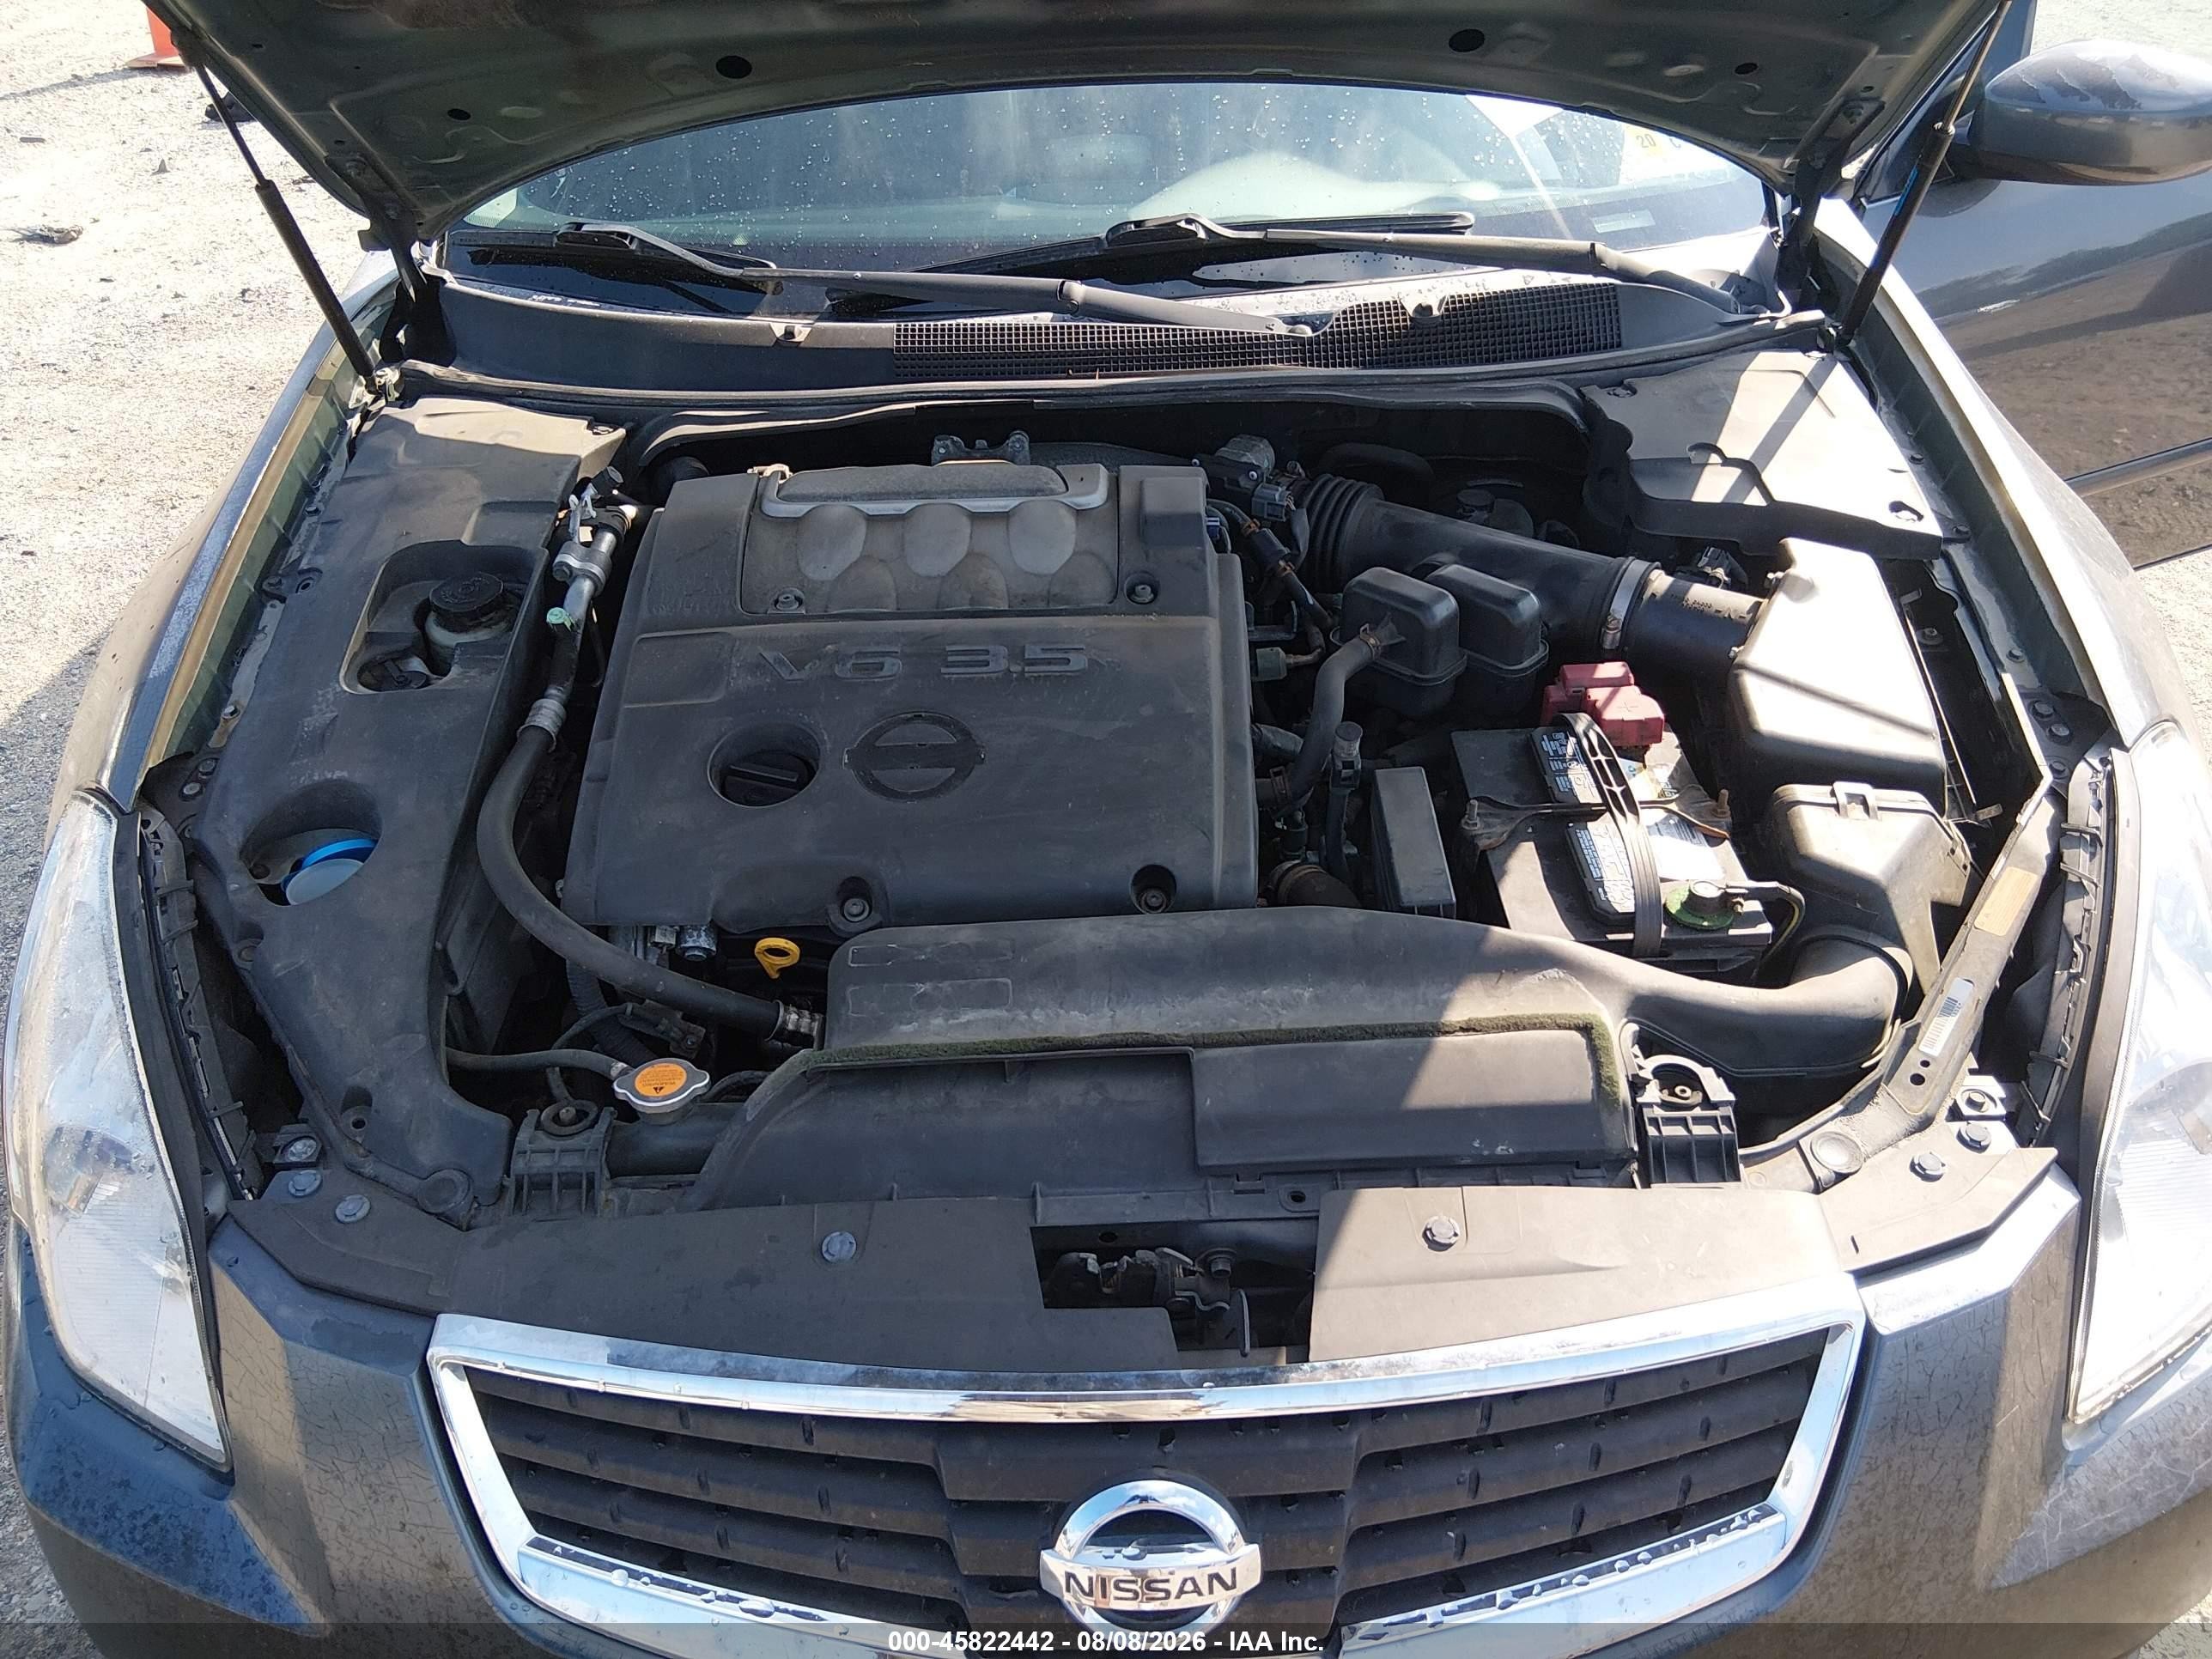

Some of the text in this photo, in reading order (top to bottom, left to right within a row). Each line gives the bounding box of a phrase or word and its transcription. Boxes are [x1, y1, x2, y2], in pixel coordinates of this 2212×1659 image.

[759, 643, 1089, 682] V6 3.5
[1064, 1567, 1237, 1601] NISSAN
